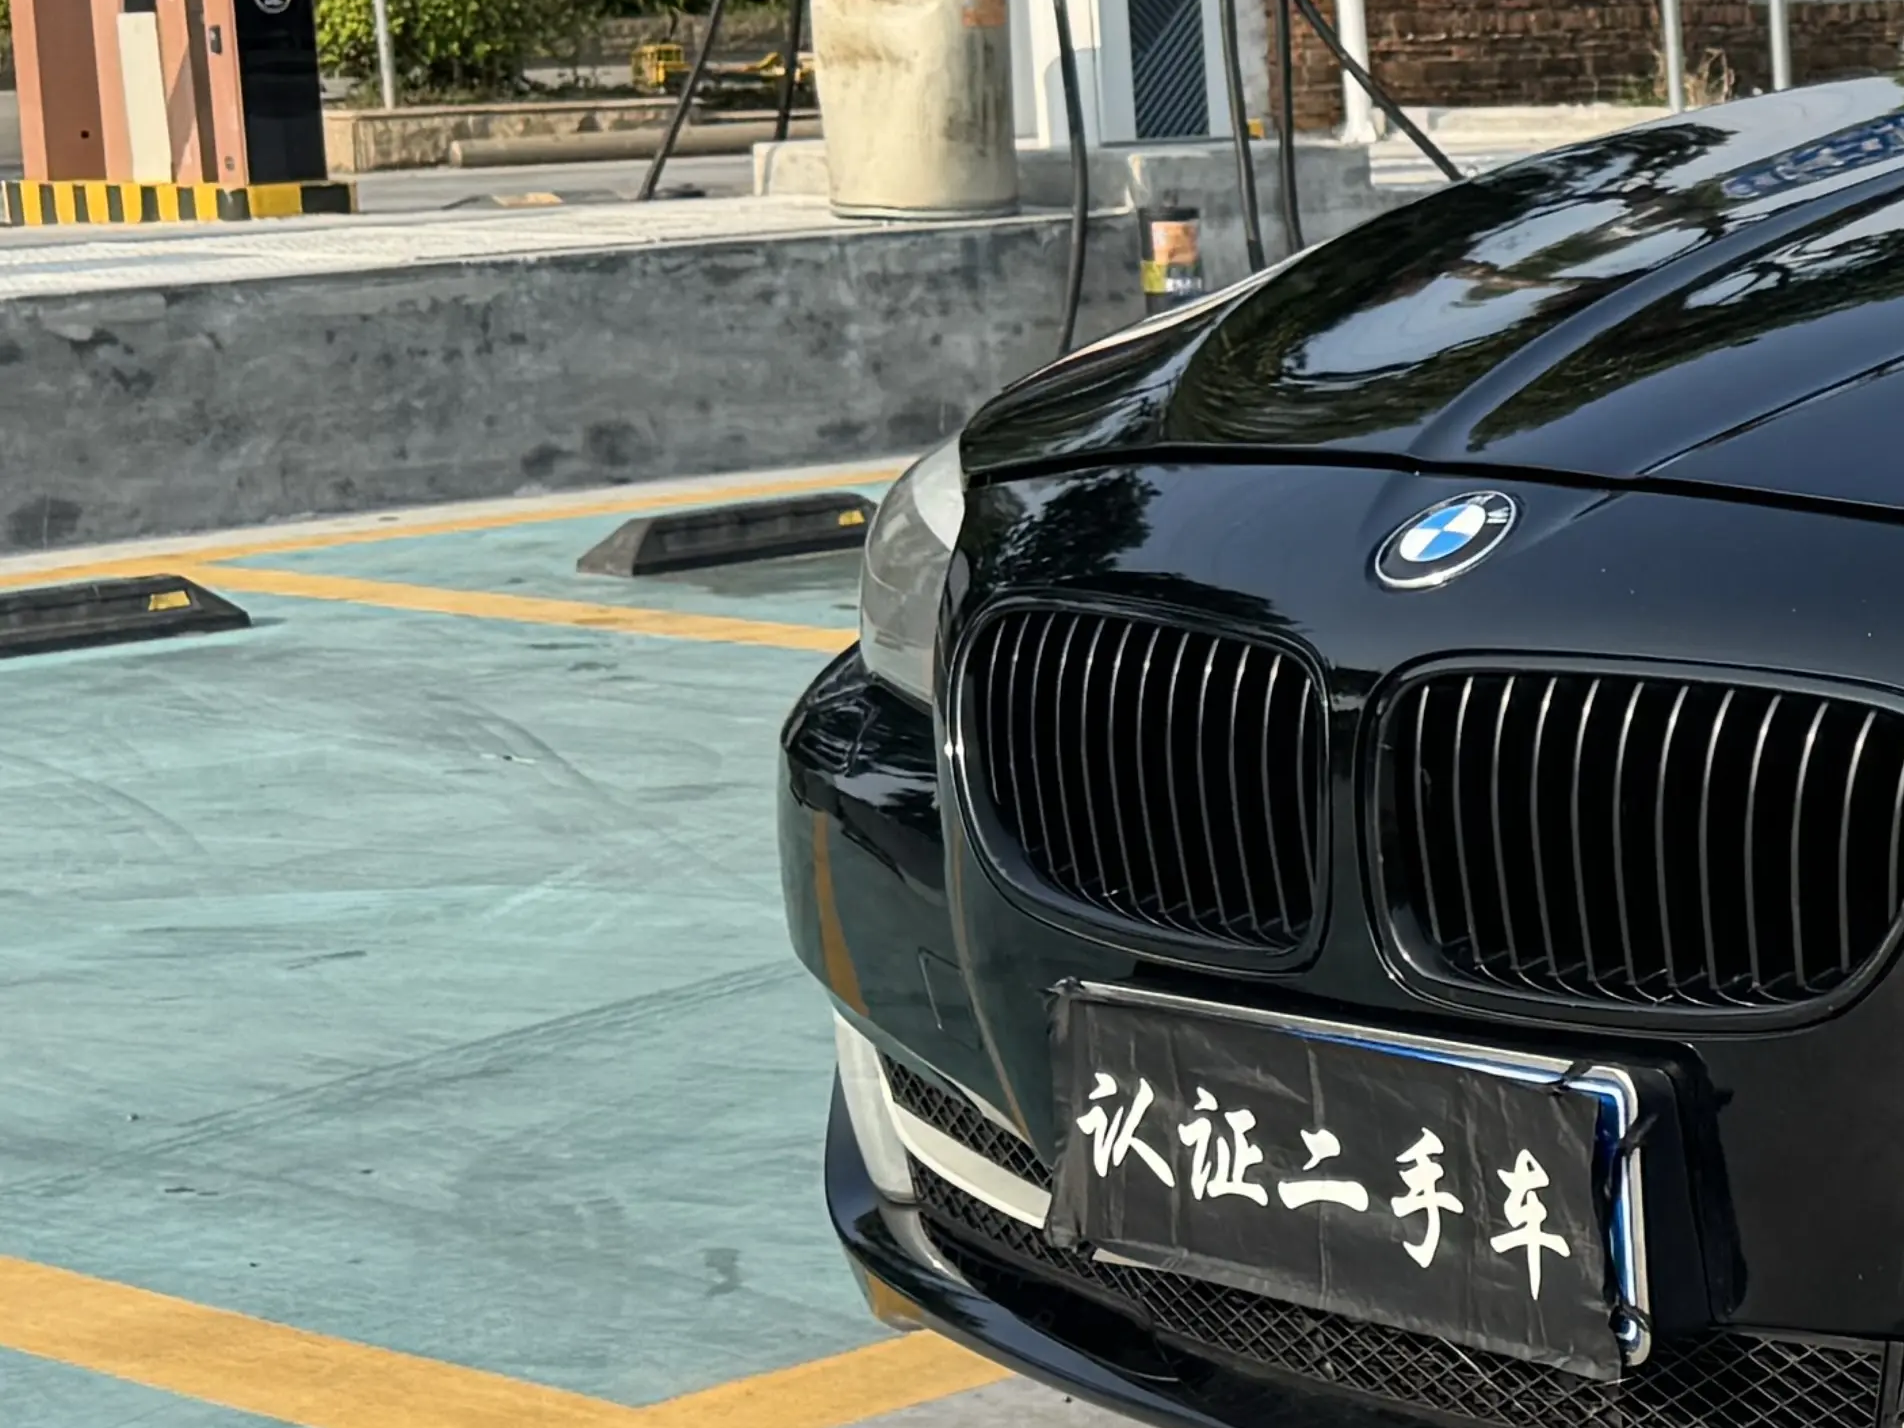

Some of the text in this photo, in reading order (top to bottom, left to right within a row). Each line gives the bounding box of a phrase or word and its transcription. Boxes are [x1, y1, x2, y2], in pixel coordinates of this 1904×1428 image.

[1078, 1072, 1571, 1301] 认证二手车
